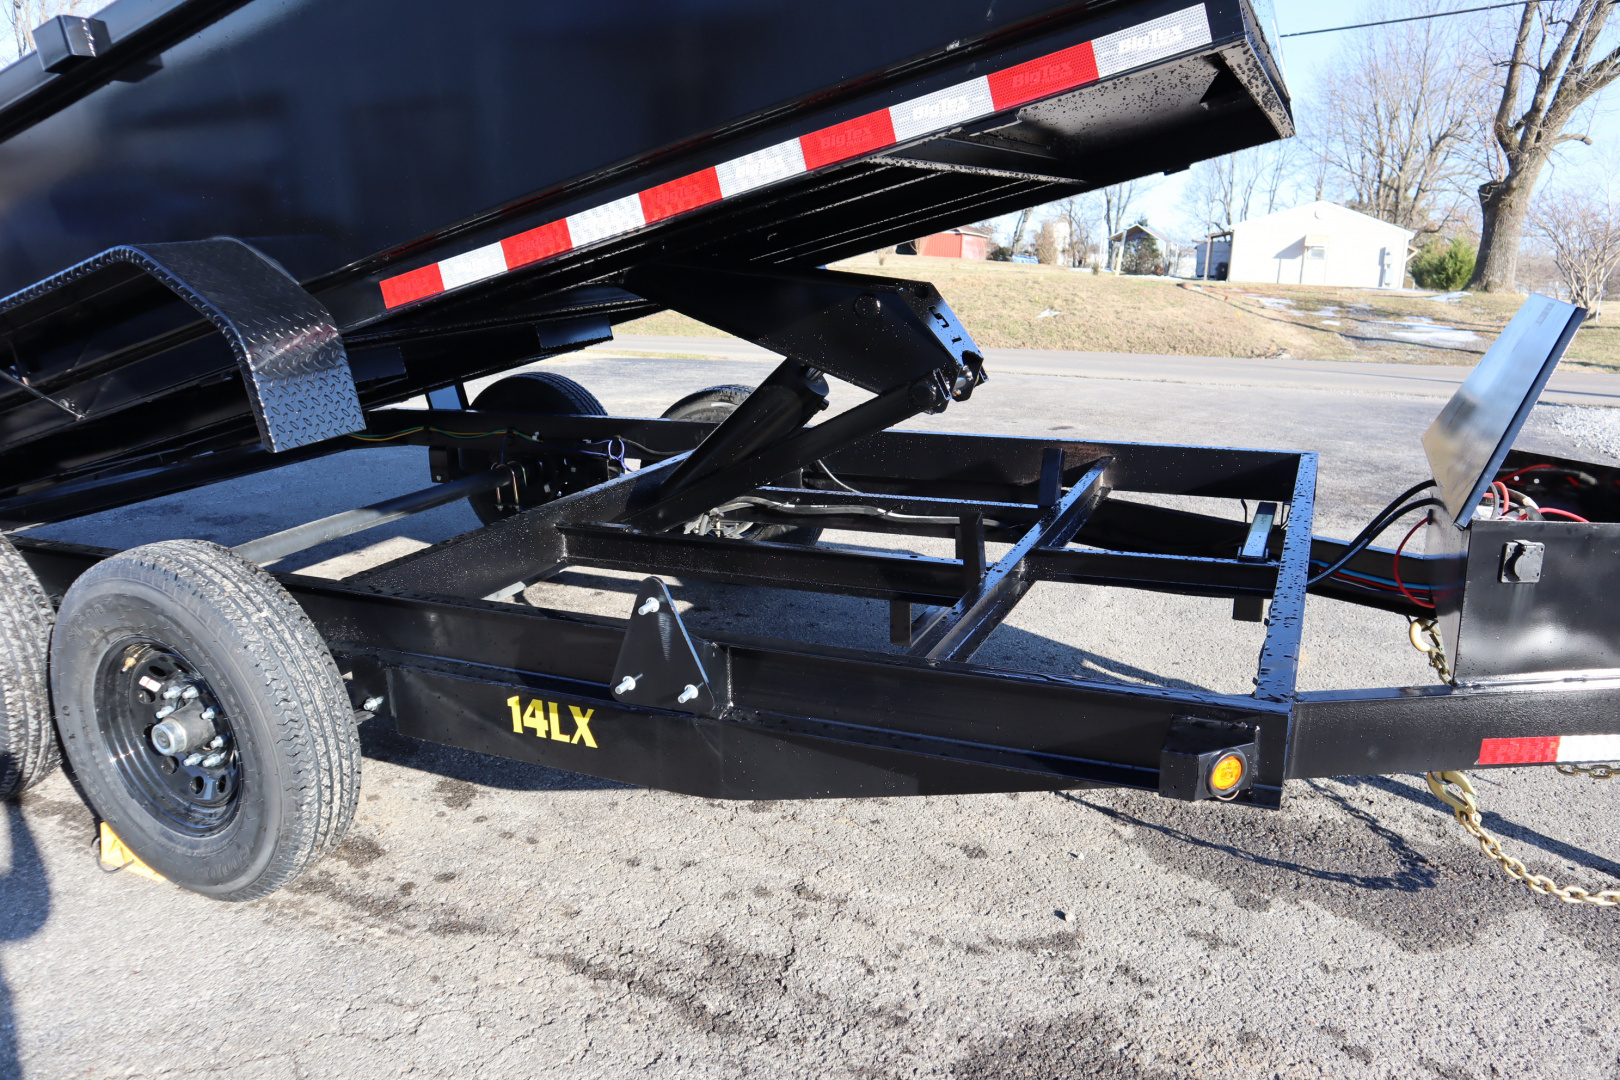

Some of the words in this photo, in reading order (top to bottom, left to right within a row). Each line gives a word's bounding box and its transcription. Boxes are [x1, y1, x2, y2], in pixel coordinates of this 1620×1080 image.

[1012, 61, 1072, 88] BigTex
[912, 94, 968, 121] BigTex
[820, 125, 872, 150] BigTex
[507, 695, 598, 748] 14LX
